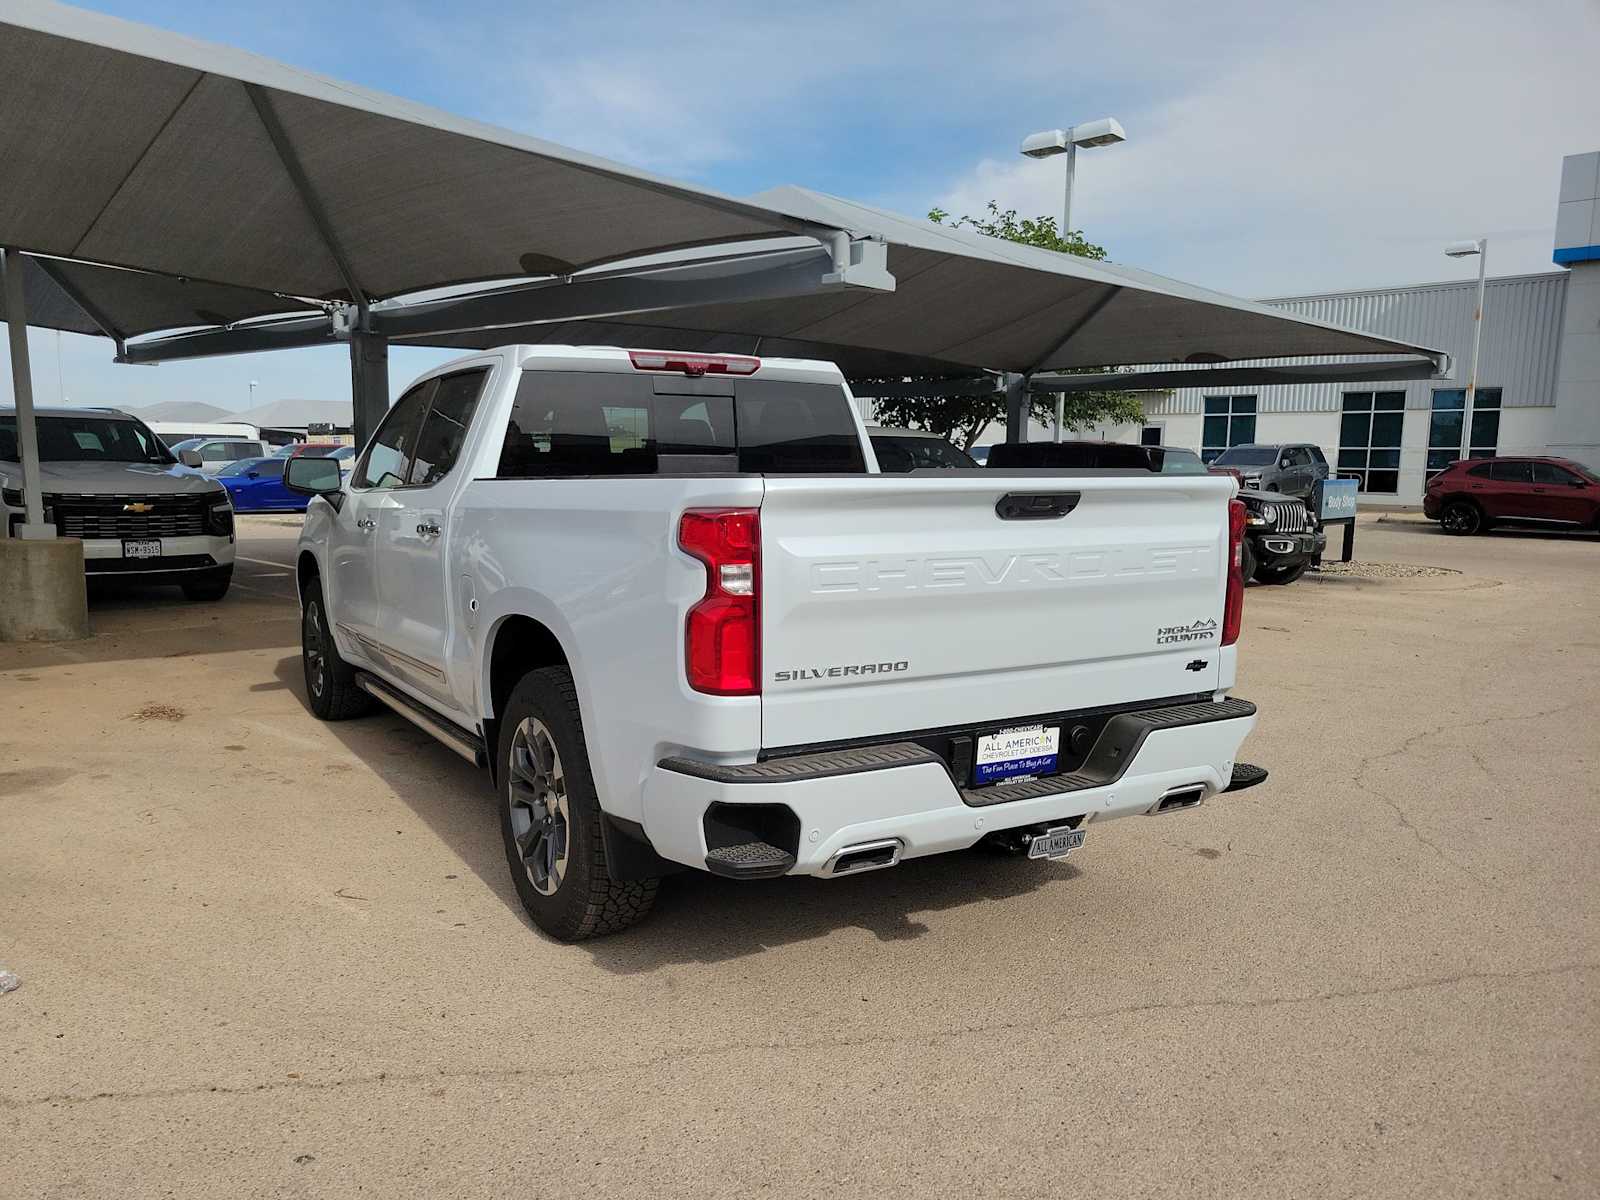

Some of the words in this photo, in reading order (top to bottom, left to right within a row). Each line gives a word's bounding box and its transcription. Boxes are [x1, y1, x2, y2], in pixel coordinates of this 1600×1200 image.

[811, 545, 1211, 593] CHEVROLET
[1157, 625, 1190, 636] HIGH
[1157, 631, 1214, 644] COUNTRY
[774, 661, 909, 682] SILVERADO
[982, 749, 1019, 760] CHEVROLET
[1029, 745, 1053, 754] ODESSA
[984, 742, 1002, 752] ALL
[1036, 839, 1048, 853] ALL
[1049, 833, 1082, 850] AMERICAN
